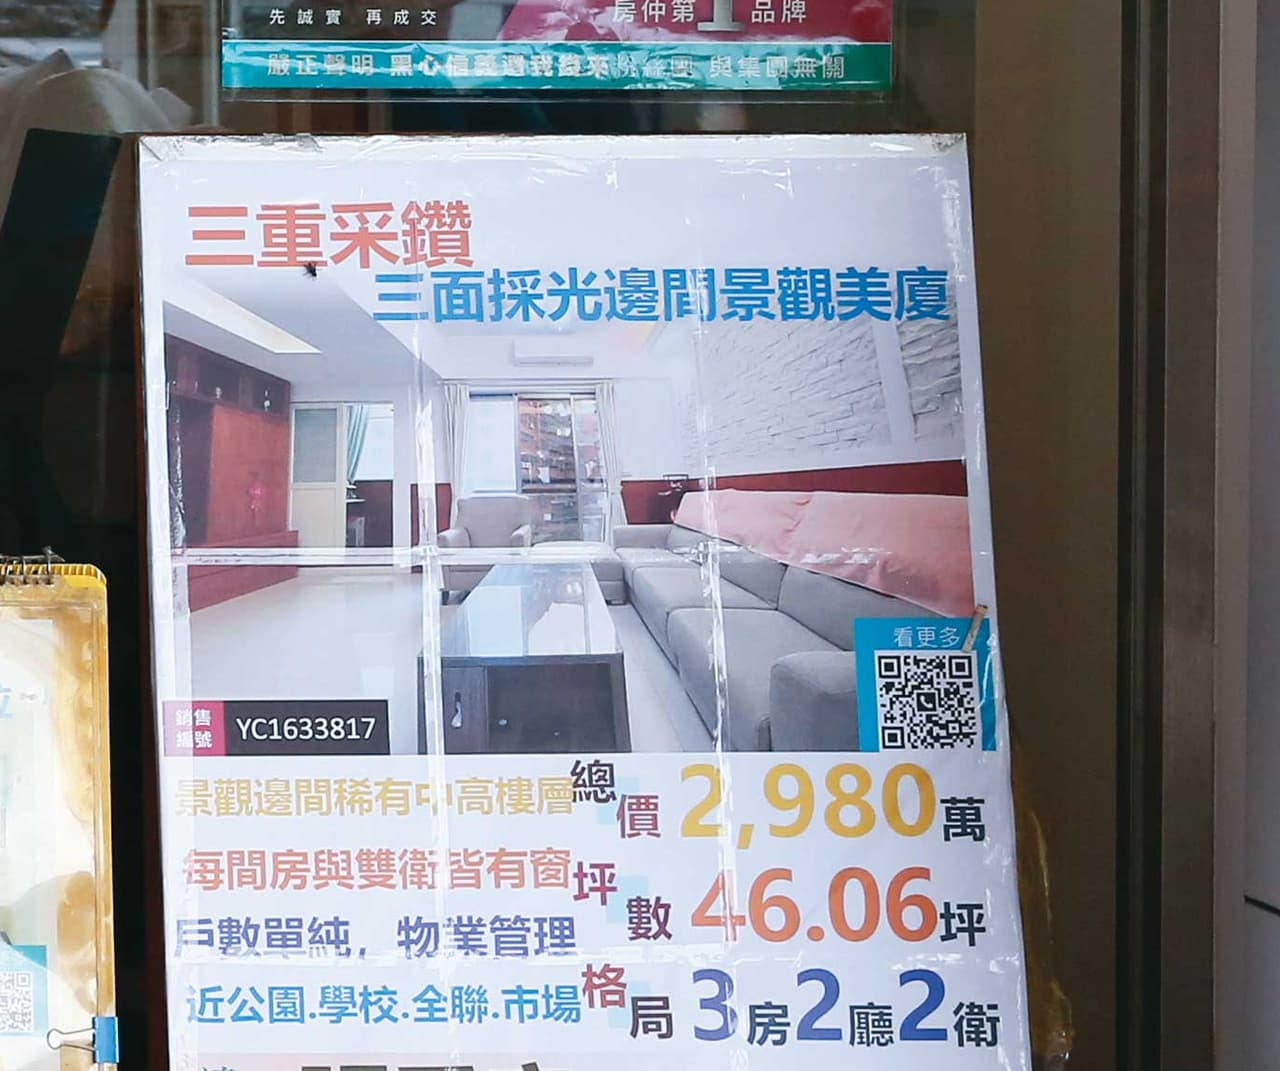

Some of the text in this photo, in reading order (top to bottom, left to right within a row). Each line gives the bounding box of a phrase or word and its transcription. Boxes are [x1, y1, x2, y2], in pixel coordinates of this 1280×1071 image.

[269, 7, 437, 26] 先誠實 再成交
[184, 201, 474, 269] 三重采鑽
[373, 268, 952, 324] 三面採光邊間景觀美廈
[892, 624, 961, 648] 看更多
[236, 717, 377, 743] YC1633817
[175, 776, 573, 818] 景觀邊間稀有中高樓層
[182, 848, 572, 892] 每間房與雙衛皆有窗
